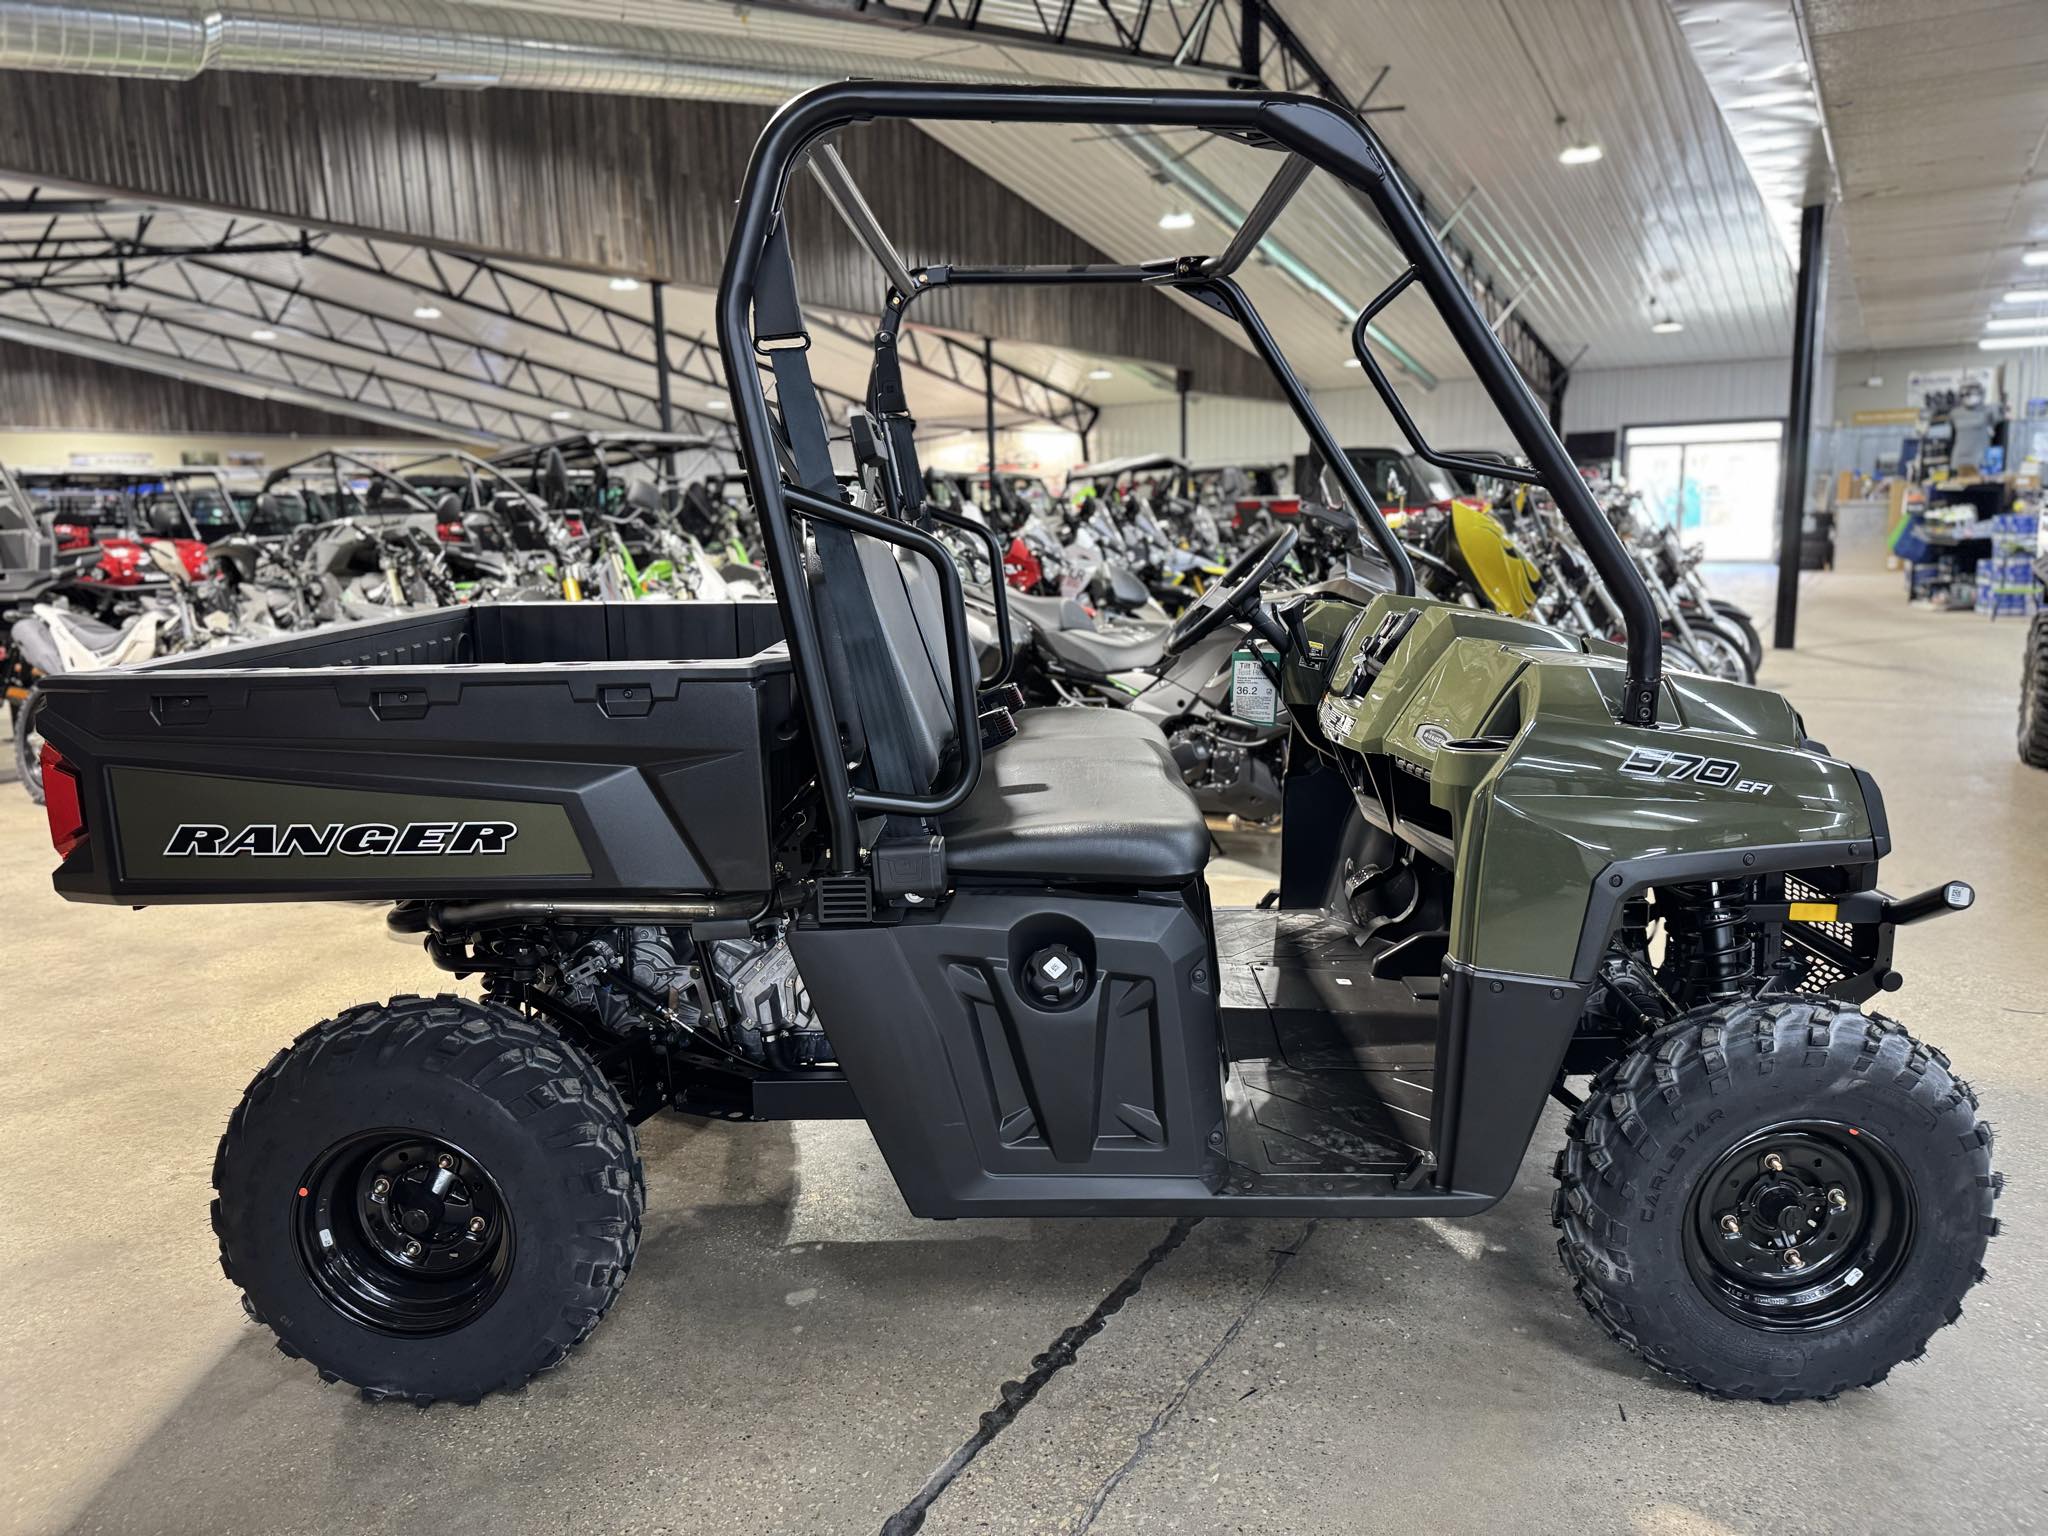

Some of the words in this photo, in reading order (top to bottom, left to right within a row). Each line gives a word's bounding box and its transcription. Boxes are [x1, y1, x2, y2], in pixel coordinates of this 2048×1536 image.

[1236, 686, 1258, 695] 36.2
[1618, 746, 1740, 786] 570
[1734, 779, 1774, 796] EFI
[163, 820, 518, 856] RANGER
[1640, 1108, 1728, 1222] CARLSTAR
